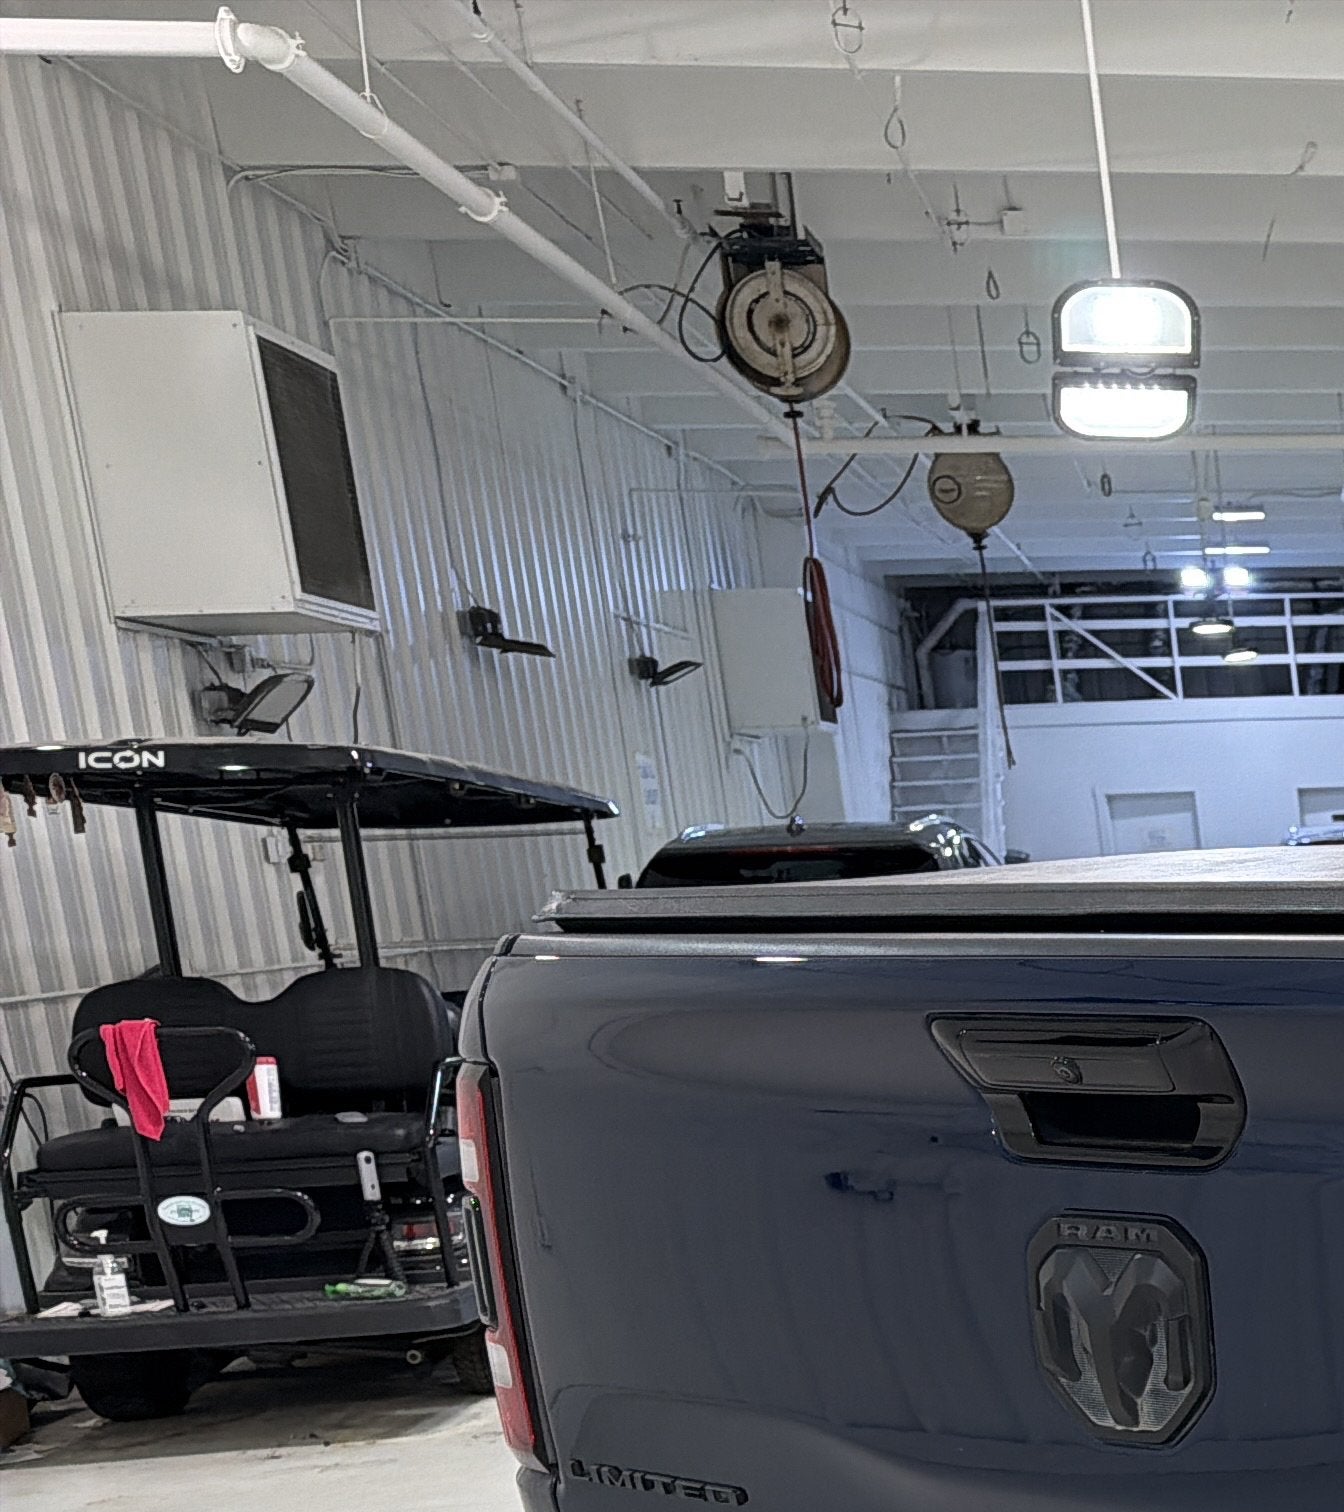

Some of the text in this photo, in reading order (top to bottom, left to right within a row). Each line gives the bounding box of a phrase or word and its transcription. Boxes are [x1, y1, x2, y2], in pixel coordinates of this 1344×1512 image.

[78, 749, 165, 770] ICON
[1057, 1223, 1159, 1243] RAM
[569, 1458, 749, 1506] LIMITED
